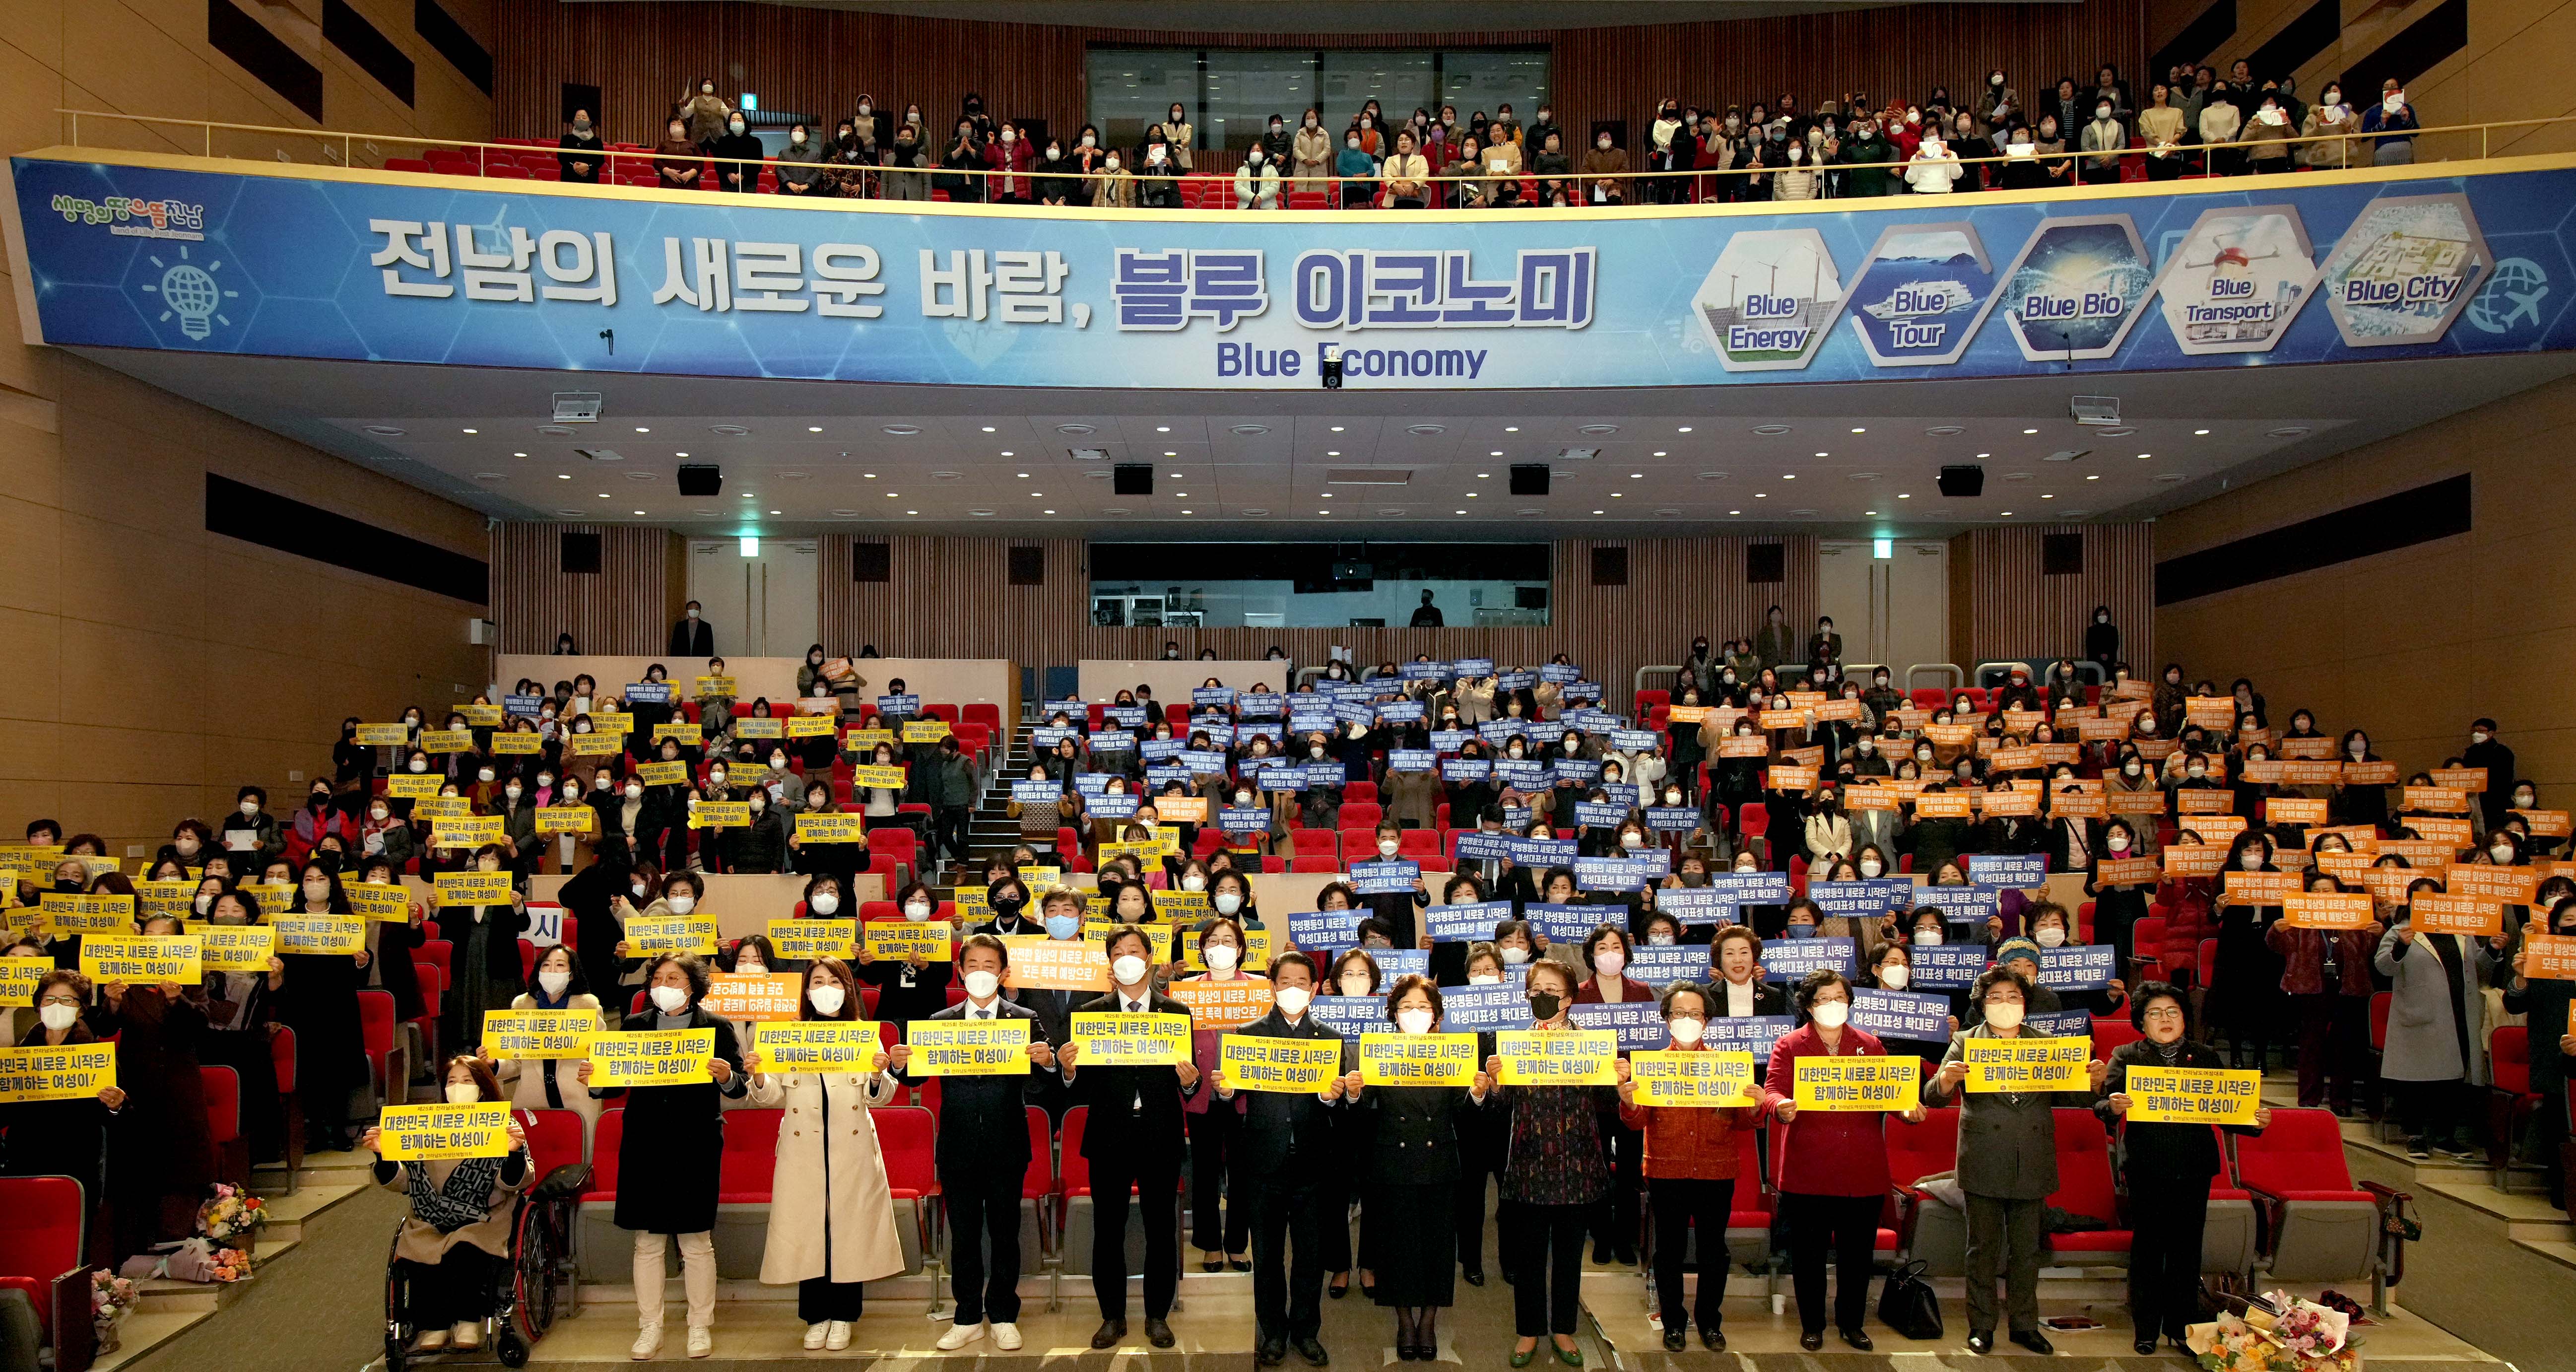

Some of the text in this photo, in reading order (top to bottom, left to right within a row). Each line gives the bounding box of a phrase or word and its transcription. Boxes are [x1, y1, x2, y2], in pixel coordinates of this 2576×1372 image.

[171, 230, 203, 239] Jeonnam
[369, 218, 1593, 330] 전남의 새로운 바람, 블루 이코노미
[2212, 279, 2251, 296] Blue
[2347, 276, 2456, 301] Blue City
[1747, 294, 1794, 315] Blue
[1895, 293, 1943, 313] Blue
[2025, 293, 2120, 317] Blue Bio
[2186, 303, 2272, 321] Transport
[1730, 327, 1806, 350] Energy
[1892, 324, 1942, 343] Tour
[1218, 343, 1300, 377] Blue
[1351, 868, 1378, 877] 양성평등의
[1357, 878, 1414, 888] 여성대표성 확대로!
[1811, 888, 1889, 898] 양성평등의 새로운 시작은!
[1819, 900, 1883, 910] 여성대표성 확대로!
[2285, 898, 2373, 911] 안전한 일상의 새로운 시작은!
[2298, 911, 2361, 923] 모든 폭력 예방으로!
[771, 927, 852, 938] 대한민국 새로운 시작은!
[84, 945, 197, 958] 대한민국 새로운 시작은!
[782, 941, 842, 951] 함께하는 여성이!
[1008, 947, 1032, 962] 안전한
[1035, 949, 1055, 961] 일상의
[1059, 950, 1082, 963] 새로운
[99, 961, 183, 975] 함께하는 여성이!
[1022, 965, 1097, 980] 모든 폭력 예방으로!
[487, 1019, 592, 1032] 대한민국 새로운 시작은!
[1076, 1022, 1186, 1035] 대한민국 새로운 시작은!
[500, 1036, 579, 1049] 함께하는 여성이!
[760, 1030, 874, 1043] 대한민국 새로운 시작은!
[912, 1030, 1025, 1045] 대한민국 새로운 시작은!
[595, 1039, 710, 1056] 대한민국 새로운 시작은!
[1091, 1039, 1174, 1054] 함께하는 여성이!
[1364, 1043, 1473, 1058] 대한민국 새로운 시작은!
[1502, 1041, 1612, 1055] 대한민국 새로운 시작은!
[32, 1053, 110, 1071] 새로운 시작은!
[775, 1047, 860, 1062] 함께하는 여성이!
[928, 1049, 1012, 1064] 함께하는 여성이!
[1226, 1045, 1336, 1064] 대한민국 새로운 시작은!
[1969, 1048, 2086, 1062] 대한민국 새로운 시작은!
[610, 1059, 696, 1075] 함께하는 여성이!
[1240, 1065, 1323, 1082] 함께하는 여성이!
[1379, 1062, 1461, 1076] 함께하는 여성이!
[1517, 1060, 1599, 1074] 함께하는 여성이!
[1636, 1061, 1749, 1077] 대한민국 새로운 시작은!
[1799, 1067, 1915, 1082] 대한민국 새로운 시작은!
[1984, 1066, 2072, 1080] 함께하는 여성이!
[53, 1073, 96, 1089] 여성이!
[1651, 1081, 1736, 1096] 함께하는 여성이!
[2132, 1077, 2255, 1095] 대한민국 새로운 시작은!
[1815, 1086, 1901, 1100] 함께하는 여성이!
[2148, 1096, 2240, 1113] 함께하는 여성이!
[385, 1112, 505, 1130] 대한민국 새로운 시작은!
[400, 1132, 490, 1150] 함께하는 여성이!
